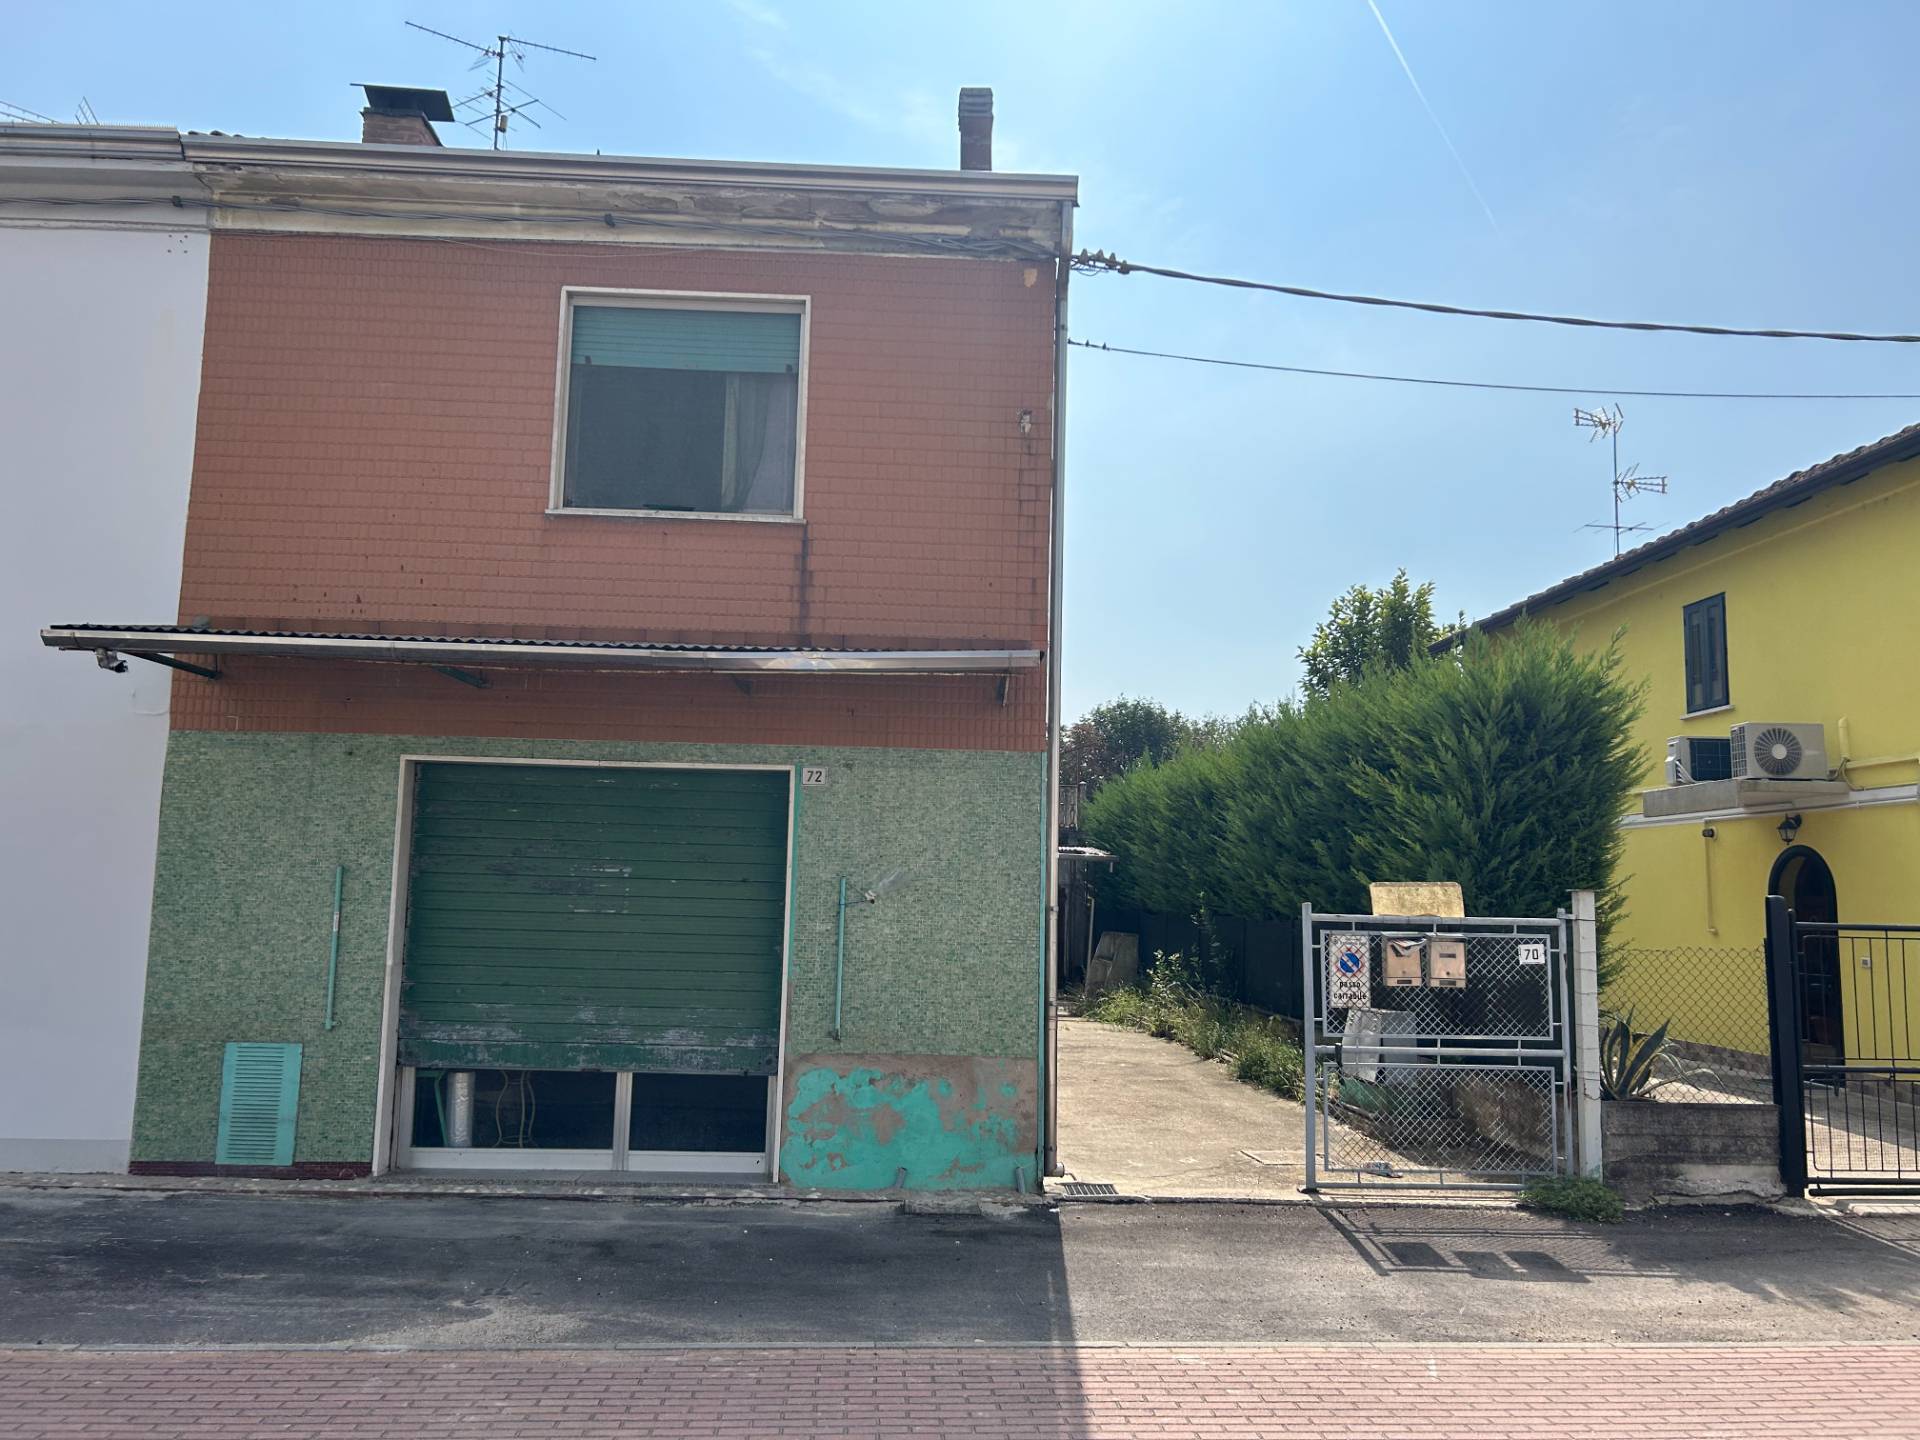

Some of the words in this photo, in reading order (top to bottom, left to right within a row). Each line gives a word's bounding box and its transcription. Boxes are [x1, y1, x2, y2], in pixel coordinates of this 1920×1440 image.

[807, 770, 822, 783] 72
[1524, 948, 1539, 960] 70
[1339, 981, 1361, 990] passo
